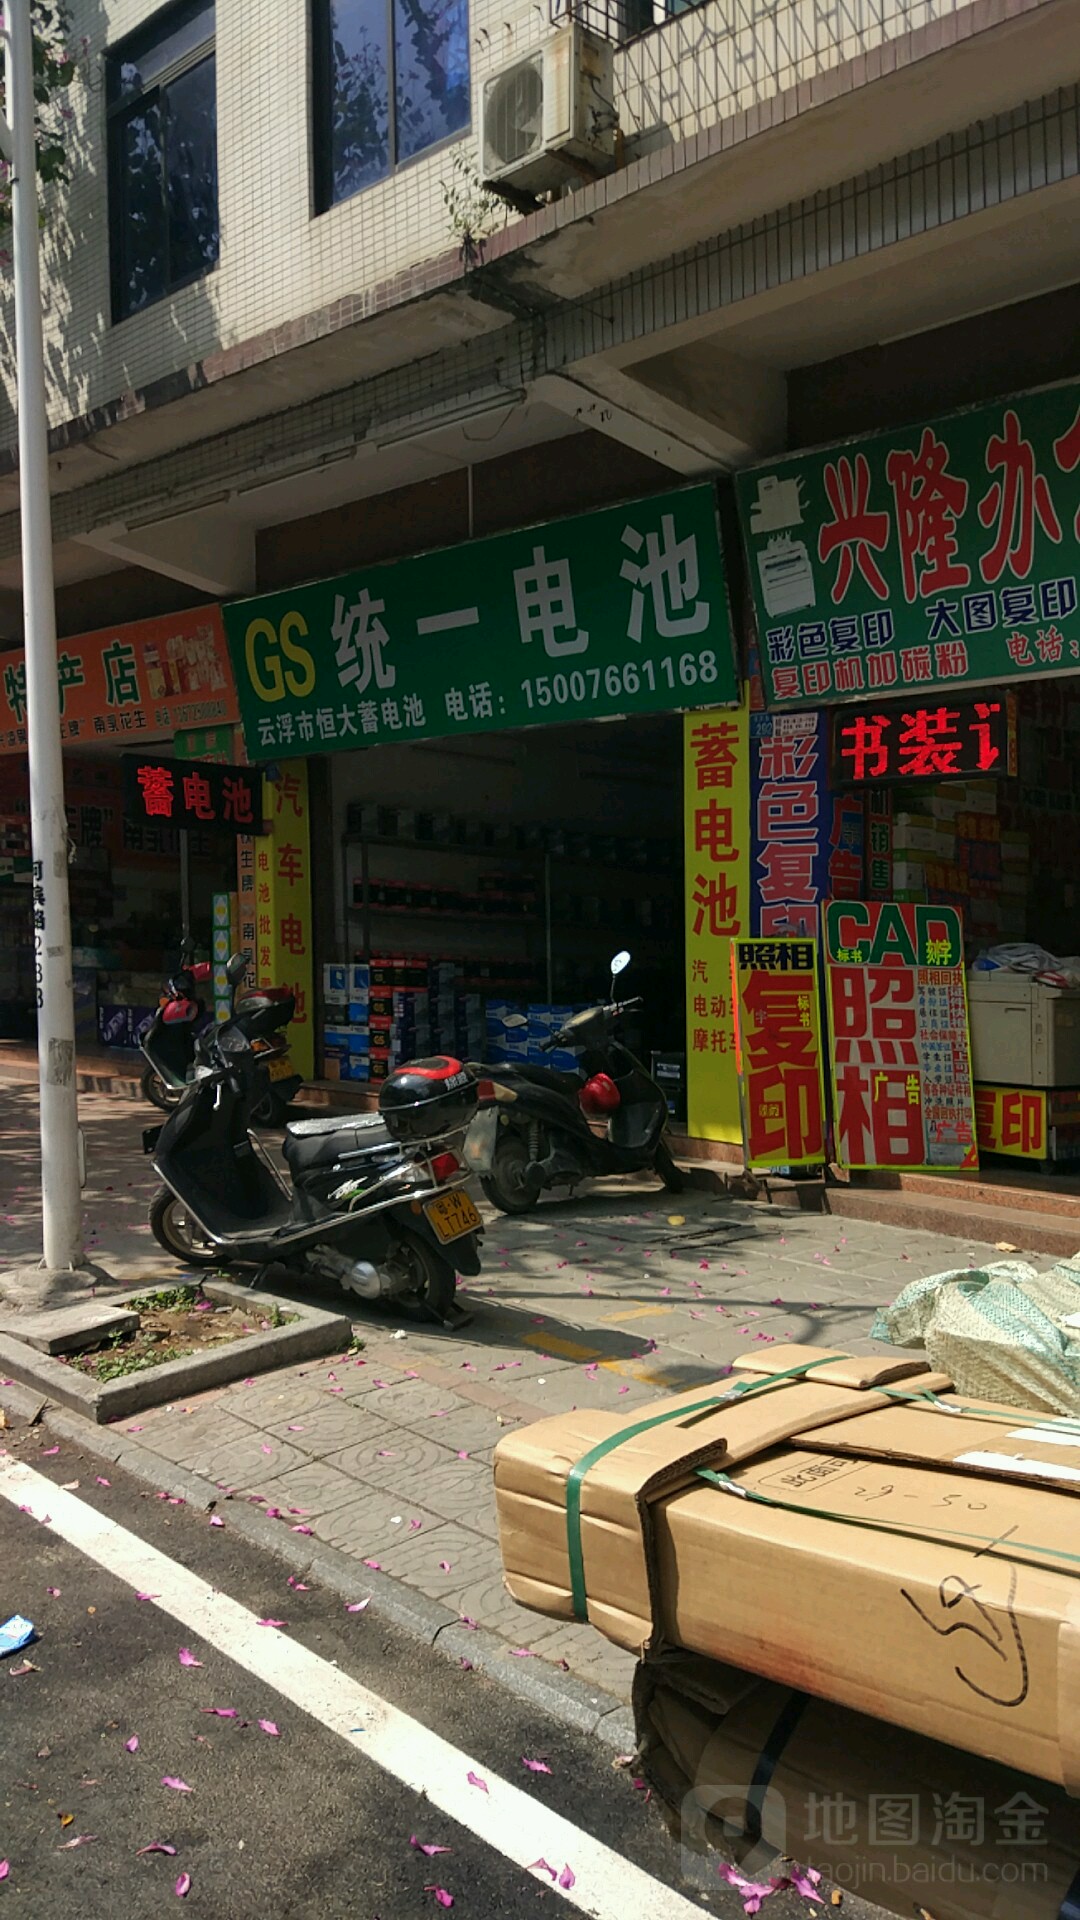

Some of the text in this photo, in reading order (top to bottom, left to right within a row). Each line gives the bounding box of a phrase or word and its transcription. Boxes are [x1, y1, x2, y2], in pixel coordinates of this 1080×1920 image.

[245, 513, 710, 702] GS 统一电池
[766, 577, 1077, 663] 彩色复印 大图复印
[257, 692, 427, 747] 云浮市恒大蓄电池
[521, 650, 718, 708] 15007661168
[771, 640, 968, 699] 复印机加碳粉
[137, 765, 254, 825] 蓄电池
[690, 721, 741, 938] 蓄电池
[275, 773, 306, 1023] 汽车电池
[739, 943, 813, 970] 照相
[827, 901, 961, 967] CAD
[836, 948, 863, 964] 标书
[925, 940, 952, 966] 刻字
[742, 971, 823, 1161] 复印
[830, 966, 926, 1166] 照相
[874, 1071, 921, 1105] 广告
[935, 1120, 971, 1144] 广告
[437, 1207, 478, 1238] LT746
